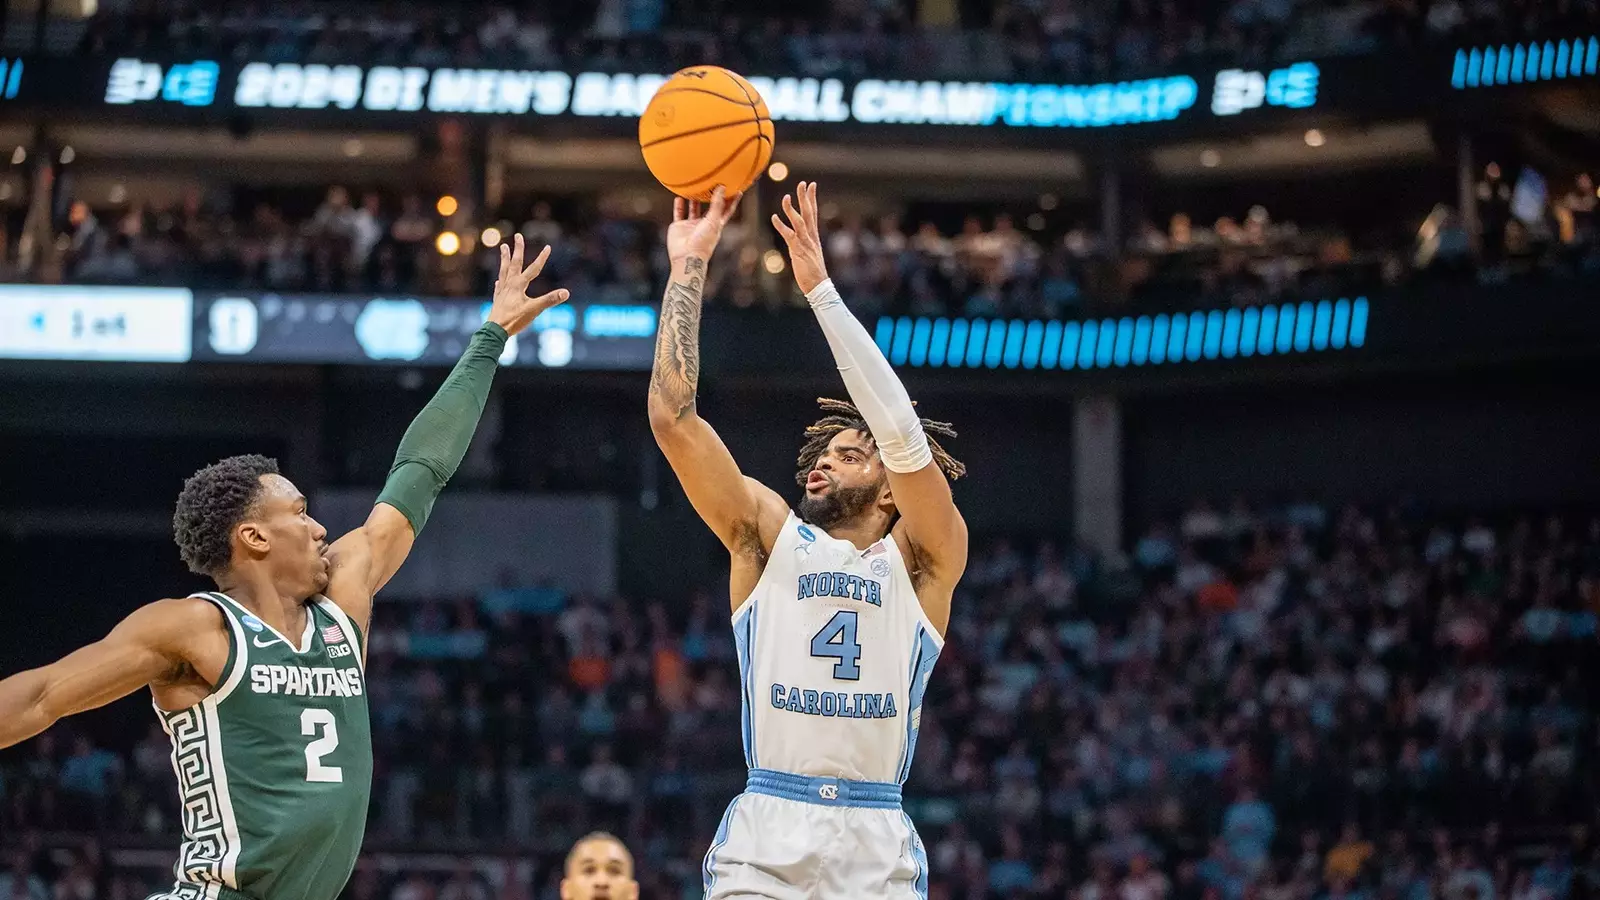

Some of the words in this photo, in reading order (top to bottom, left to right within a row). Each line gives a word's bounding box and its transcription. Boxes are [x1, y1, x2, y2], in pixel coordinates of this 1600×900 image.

[235, 63, 362, 109] 2024
[797, 571, 882, 607] NORTH
[810, 610, 862, 681] 4
[250, 664, 363, 698] SPARTANS
[771, 683, 897, 719] CAROLINA
[300, 708, 343, 783] 2
